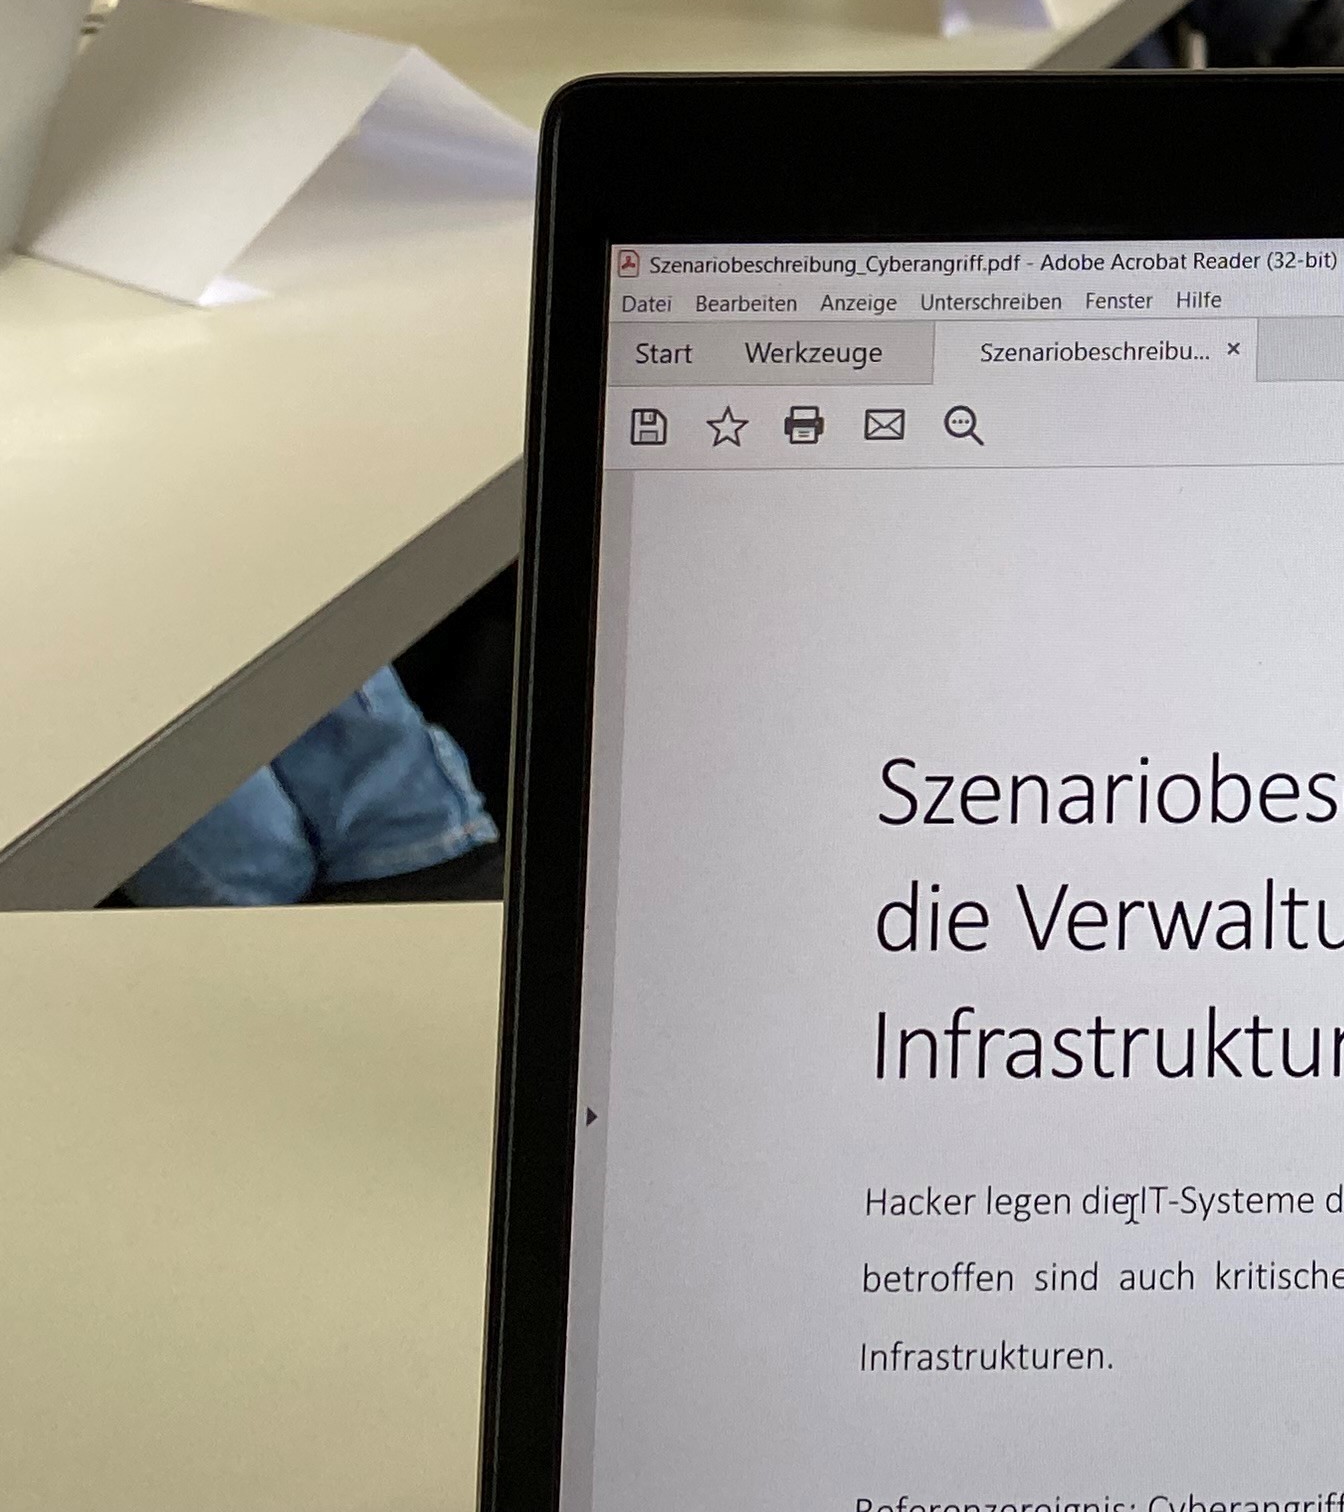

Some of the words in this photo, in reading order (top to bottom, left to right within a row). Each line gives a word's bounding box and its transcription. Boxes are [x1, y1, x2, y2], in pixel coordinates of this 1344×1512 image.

[649, 254, 1021, 278] Szenariobeschreibung_Cyberangriff.pdf
[1039, 253, 1105, 271] Adobe
[1110, 253, 1187, 271] Acrobat
[1193, 251, 1261, 270] Reader
[1266, 251, 1337, 272] (32-bit)
[622, 295, 672, 313] Datei
[696, 295, 797, 313] Bearbeiten
[820, 294, 898, 316] Anzeige
[921, 292, 1062, 311] Unterschreiben
[1085, 292, 1154, 310] Fenster
[1176, 291, 1222, 309] Hilfe
[635, 342, 693, 365] Start
[744, 340, 883, 371] Werkzeuge
[980, 340, 1210, 363] Szenariobeschreibu...
[877, 879, 989, 952] die
[866, 1185, 977, 1216] Hacker
[987, 1185, 1071, 1223] legen
[1082, 1184, 1129, 1215] die
[1140, 1184, 1315, 1222] IT-Systeme
[863, 1261, 1013, 1293] betroffen
[1034, 1260, 1098, 1292] sind
[1119, 1260, 1194, 1291] auch
[861, 1339, 1113, 1372] Infrastrukturen.
